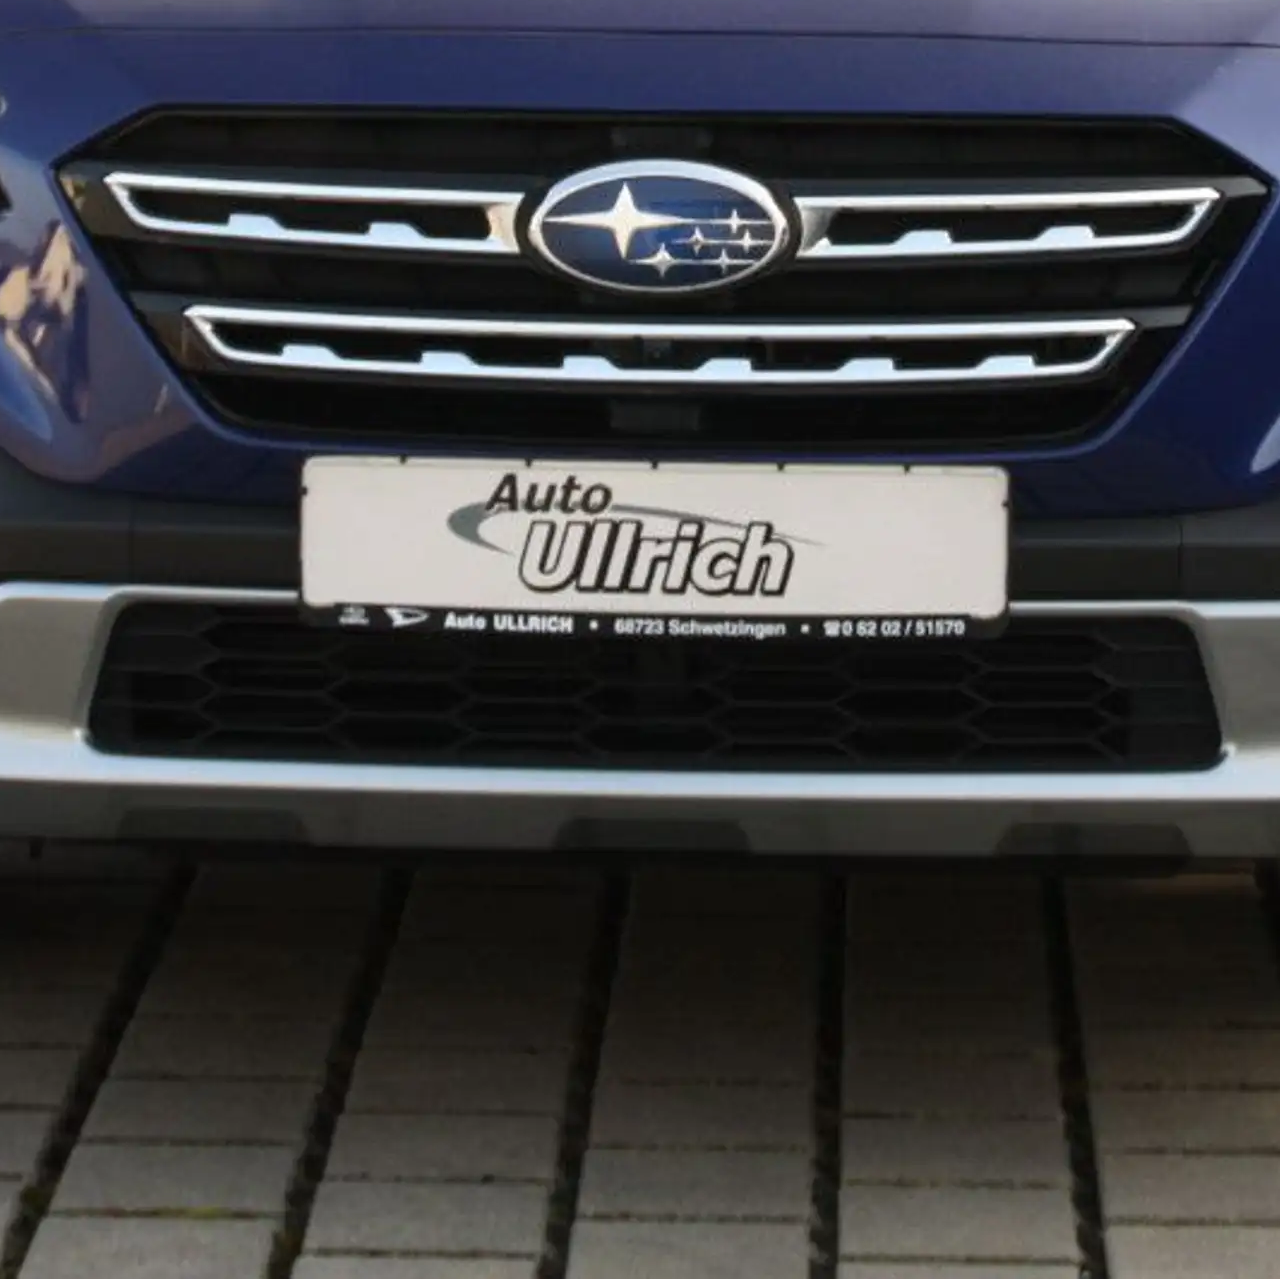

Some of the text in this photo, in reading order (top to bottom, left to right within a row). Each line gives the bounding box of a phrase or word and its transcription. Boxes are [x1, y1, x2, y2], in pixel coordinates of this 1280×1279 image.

[486, 473, 612, 514] Auto
[518, 518, 795, 597] Ullrich
[444, 612, 486, 630] Auto
[493, 614, 573, 633] ULLRICH
[614, 619, 664, 636] 68723
[668, 619, 786, 640] Schwetzingen
